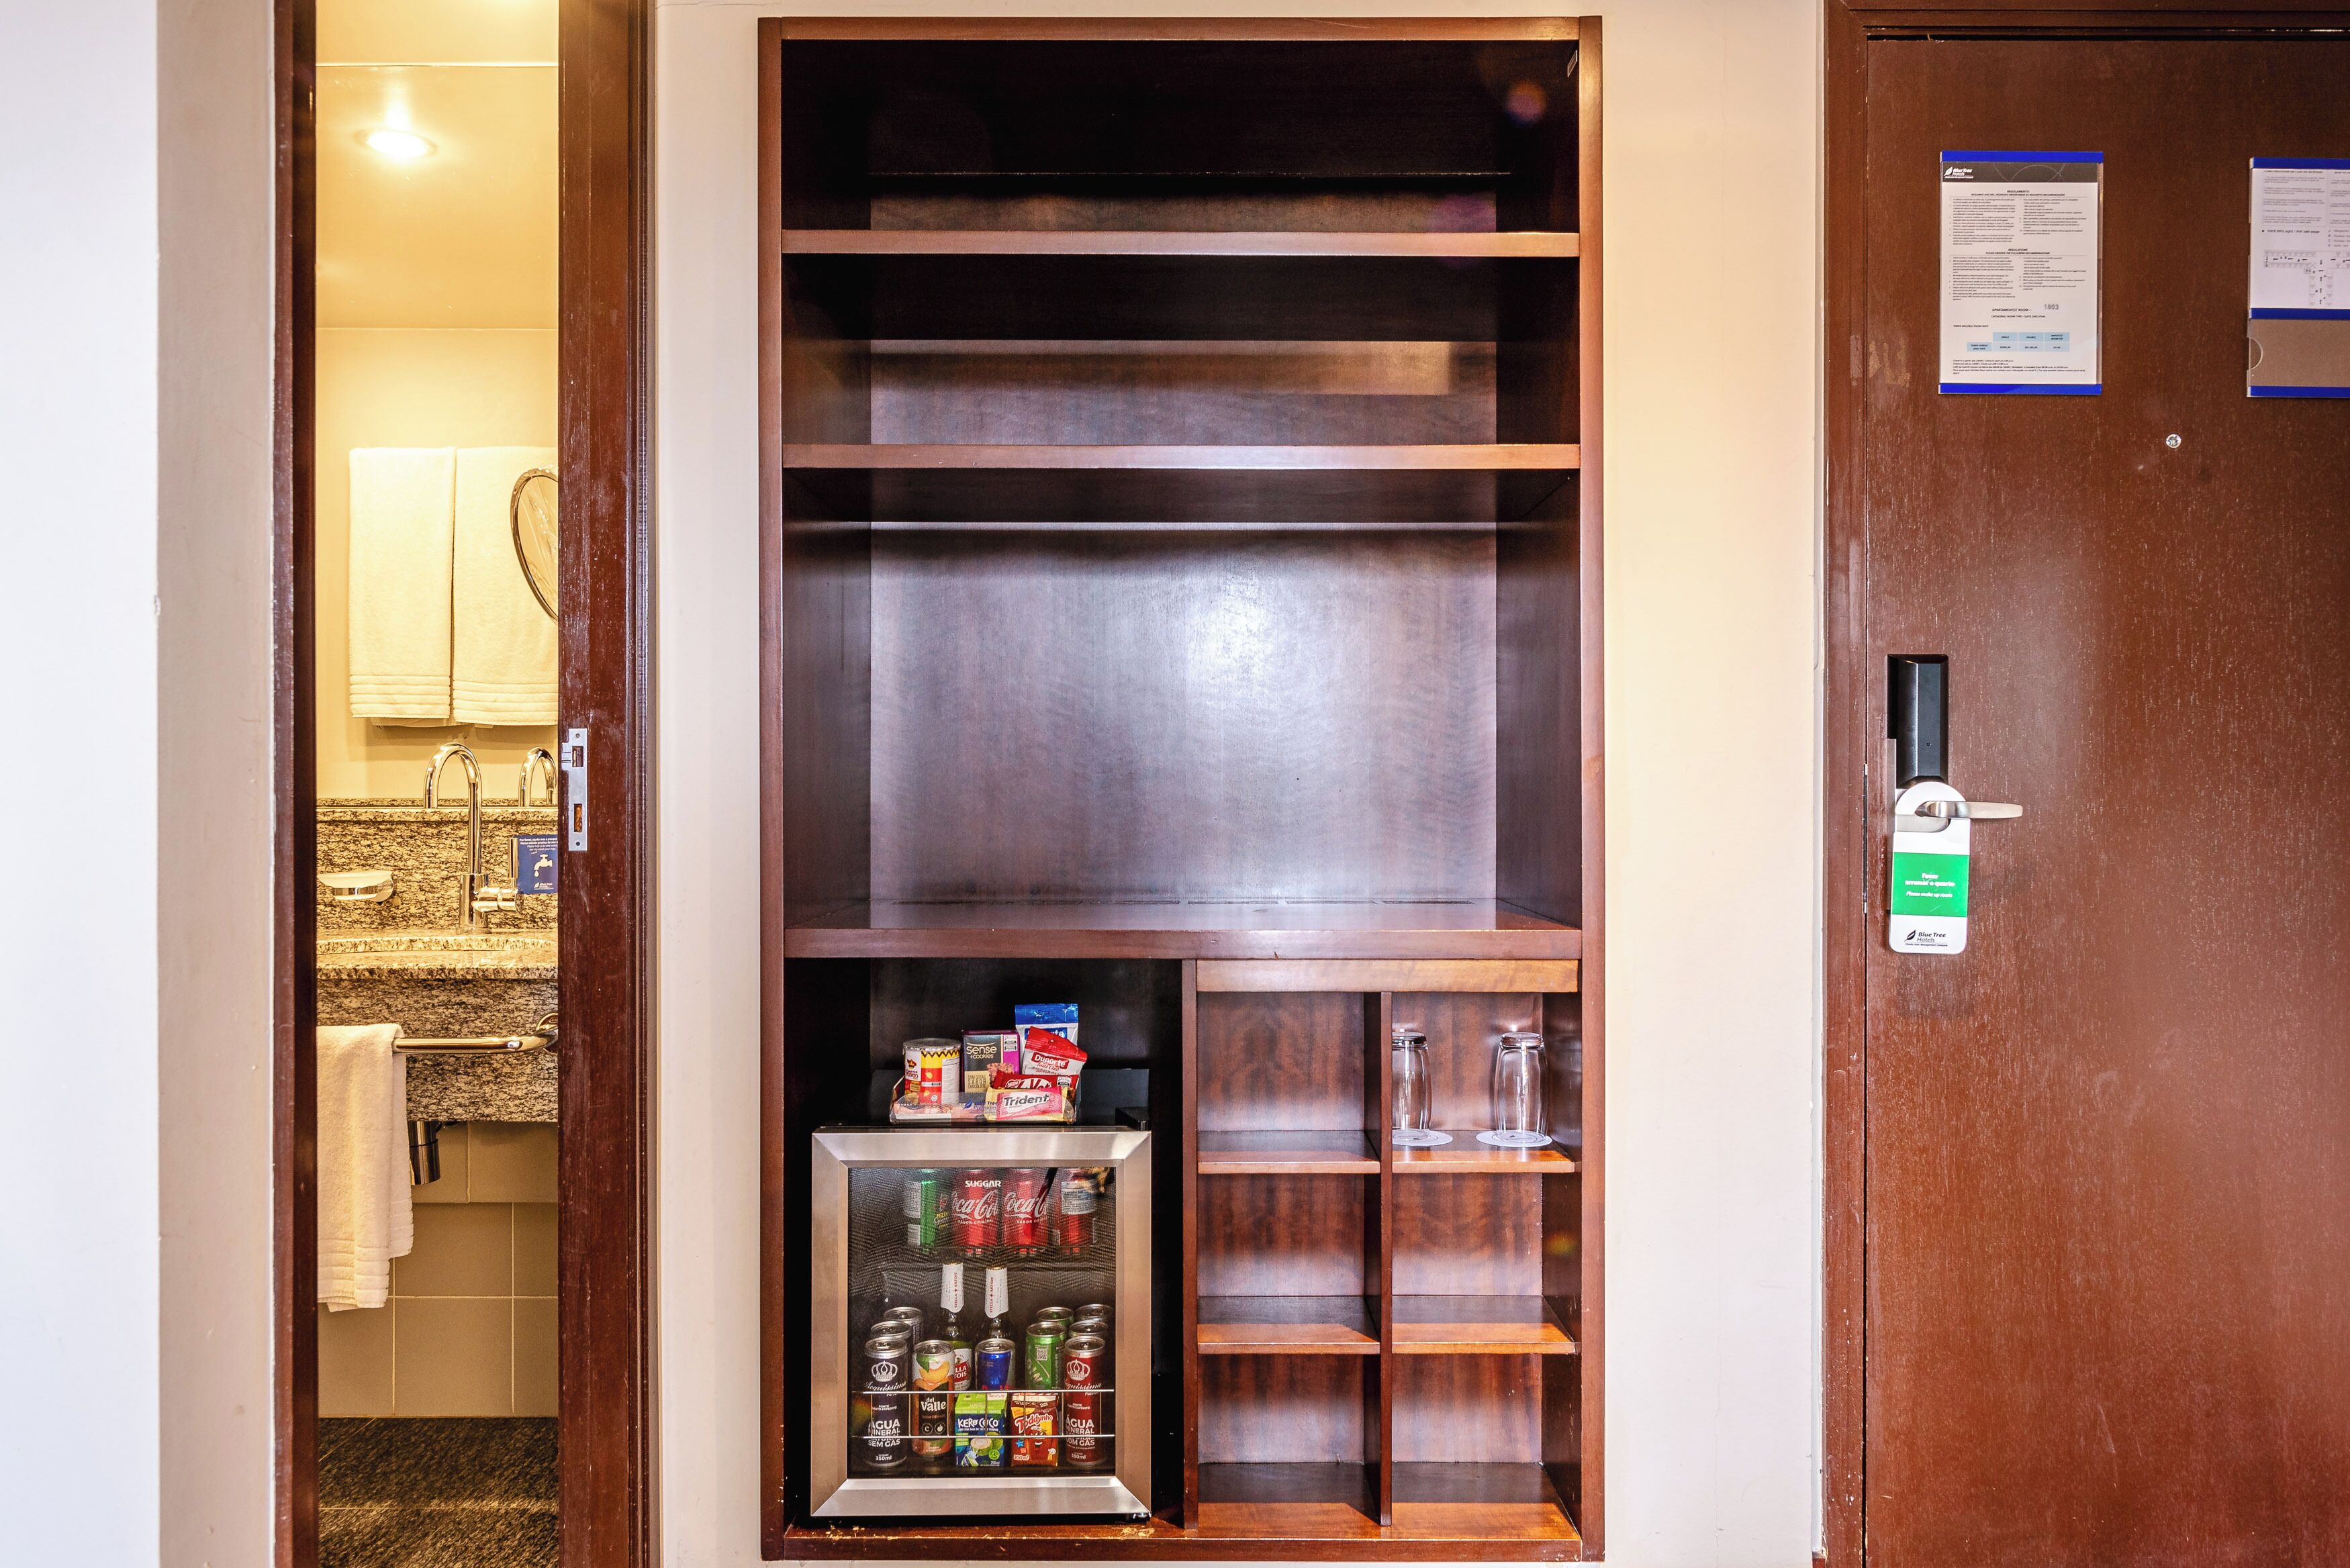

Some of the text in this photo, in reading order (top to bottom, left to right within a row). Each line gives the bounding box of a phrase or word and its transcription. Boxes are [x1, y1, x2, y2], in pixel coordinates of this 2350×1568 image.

[1034, 1054, 1066, 1067] Dunorte
[1003, 1093, 1049, 1107] Trident
[955, 1365, 967, 1373] LLA
[921, 1401, 947, 1412] Valle
[868, 1417, 900, 1430] ÁGUA
[957, 1418, 978, 1428] KERO
[1066, 1414, 1095, 1428] ÁGUA
[868, 1439, 884, 1448] SEM
